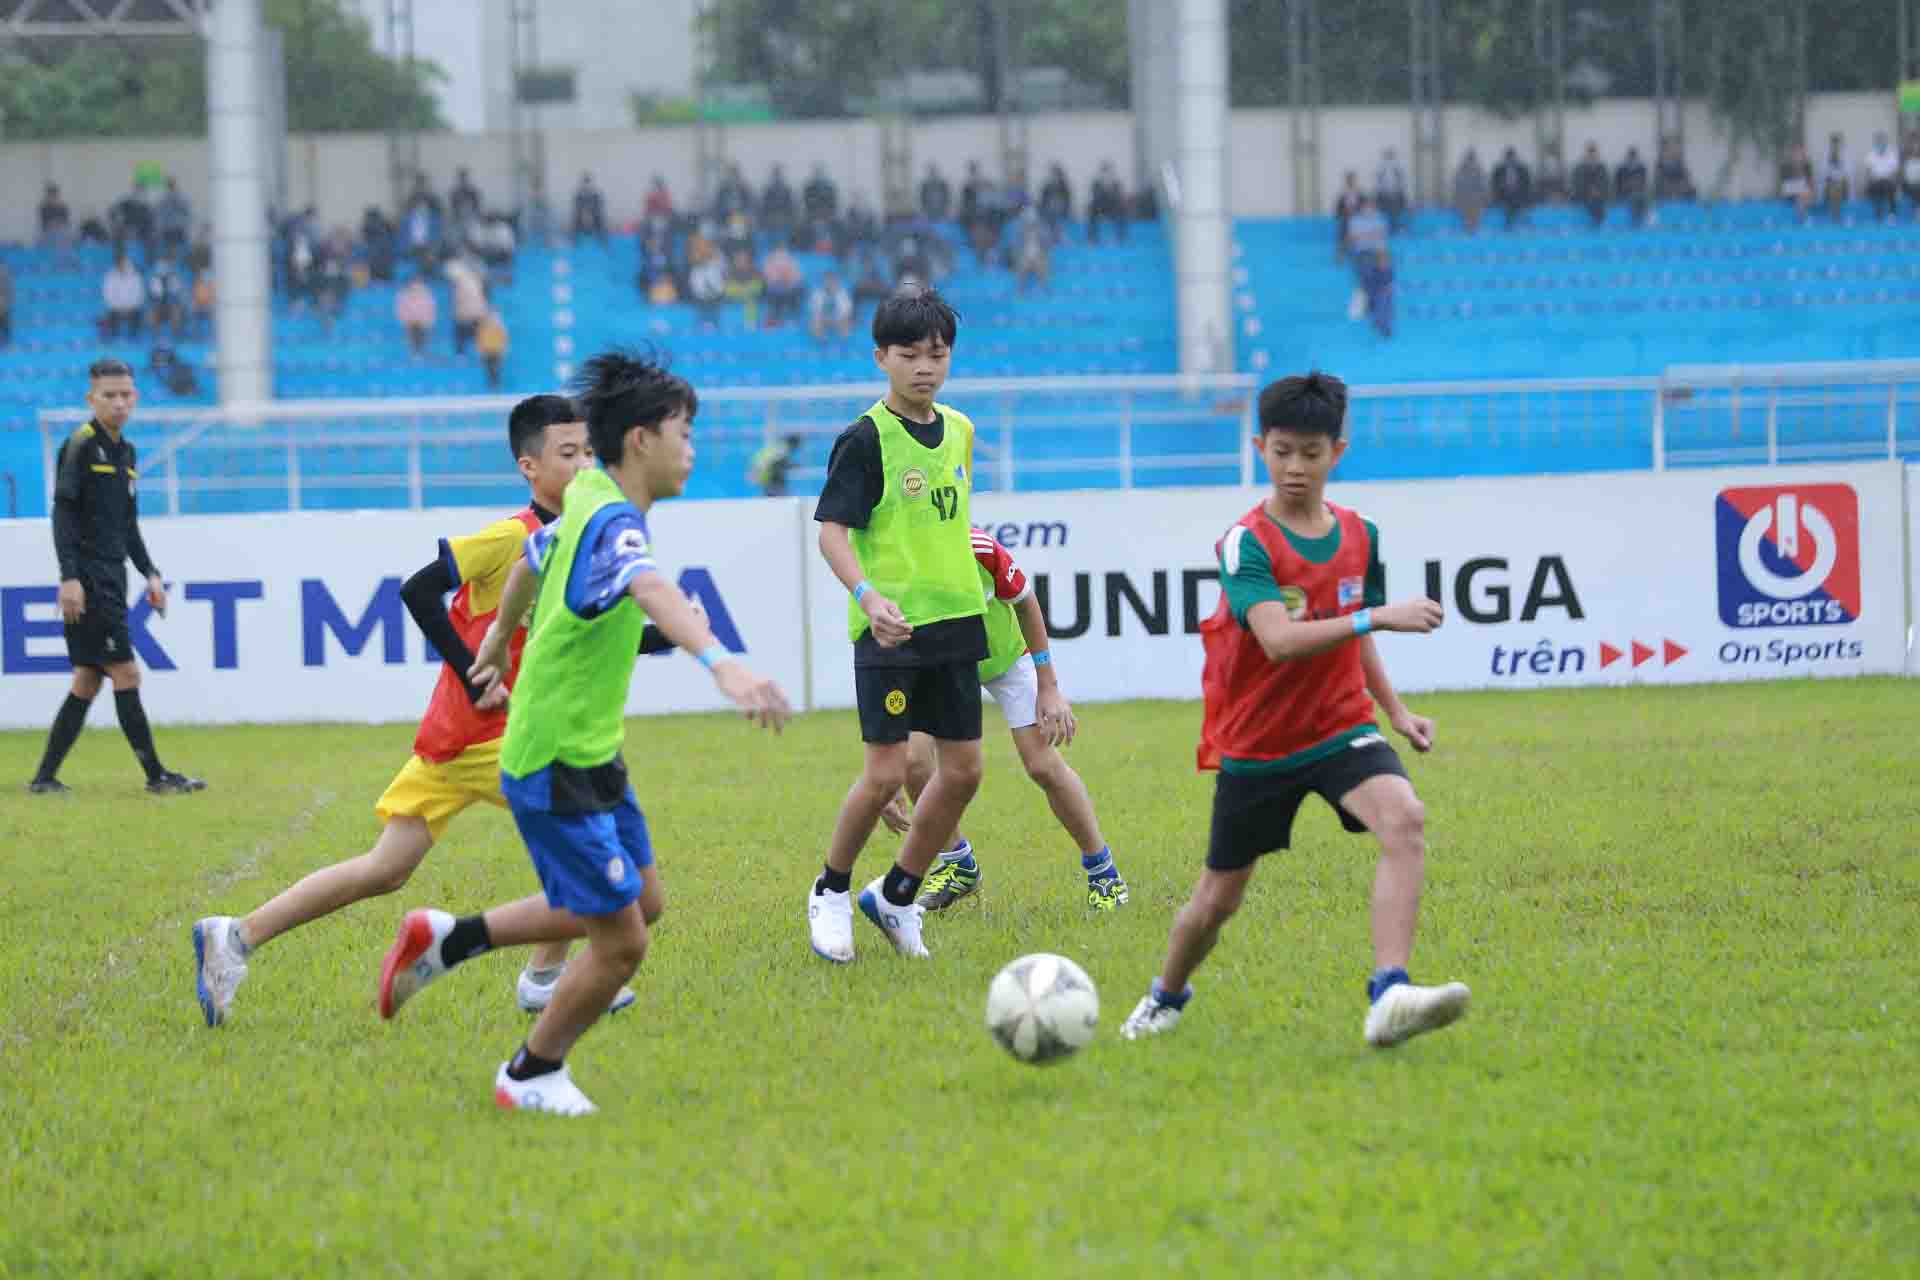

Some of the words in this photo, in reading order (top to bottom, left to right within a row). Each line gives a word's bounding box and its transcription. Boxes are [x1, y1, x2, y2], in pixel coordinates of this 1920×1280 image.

[930, 486, 958, 521] 47
[1737, 600, 1843, 625] SPORTS
[1490, 638, 1585, 676] trên
